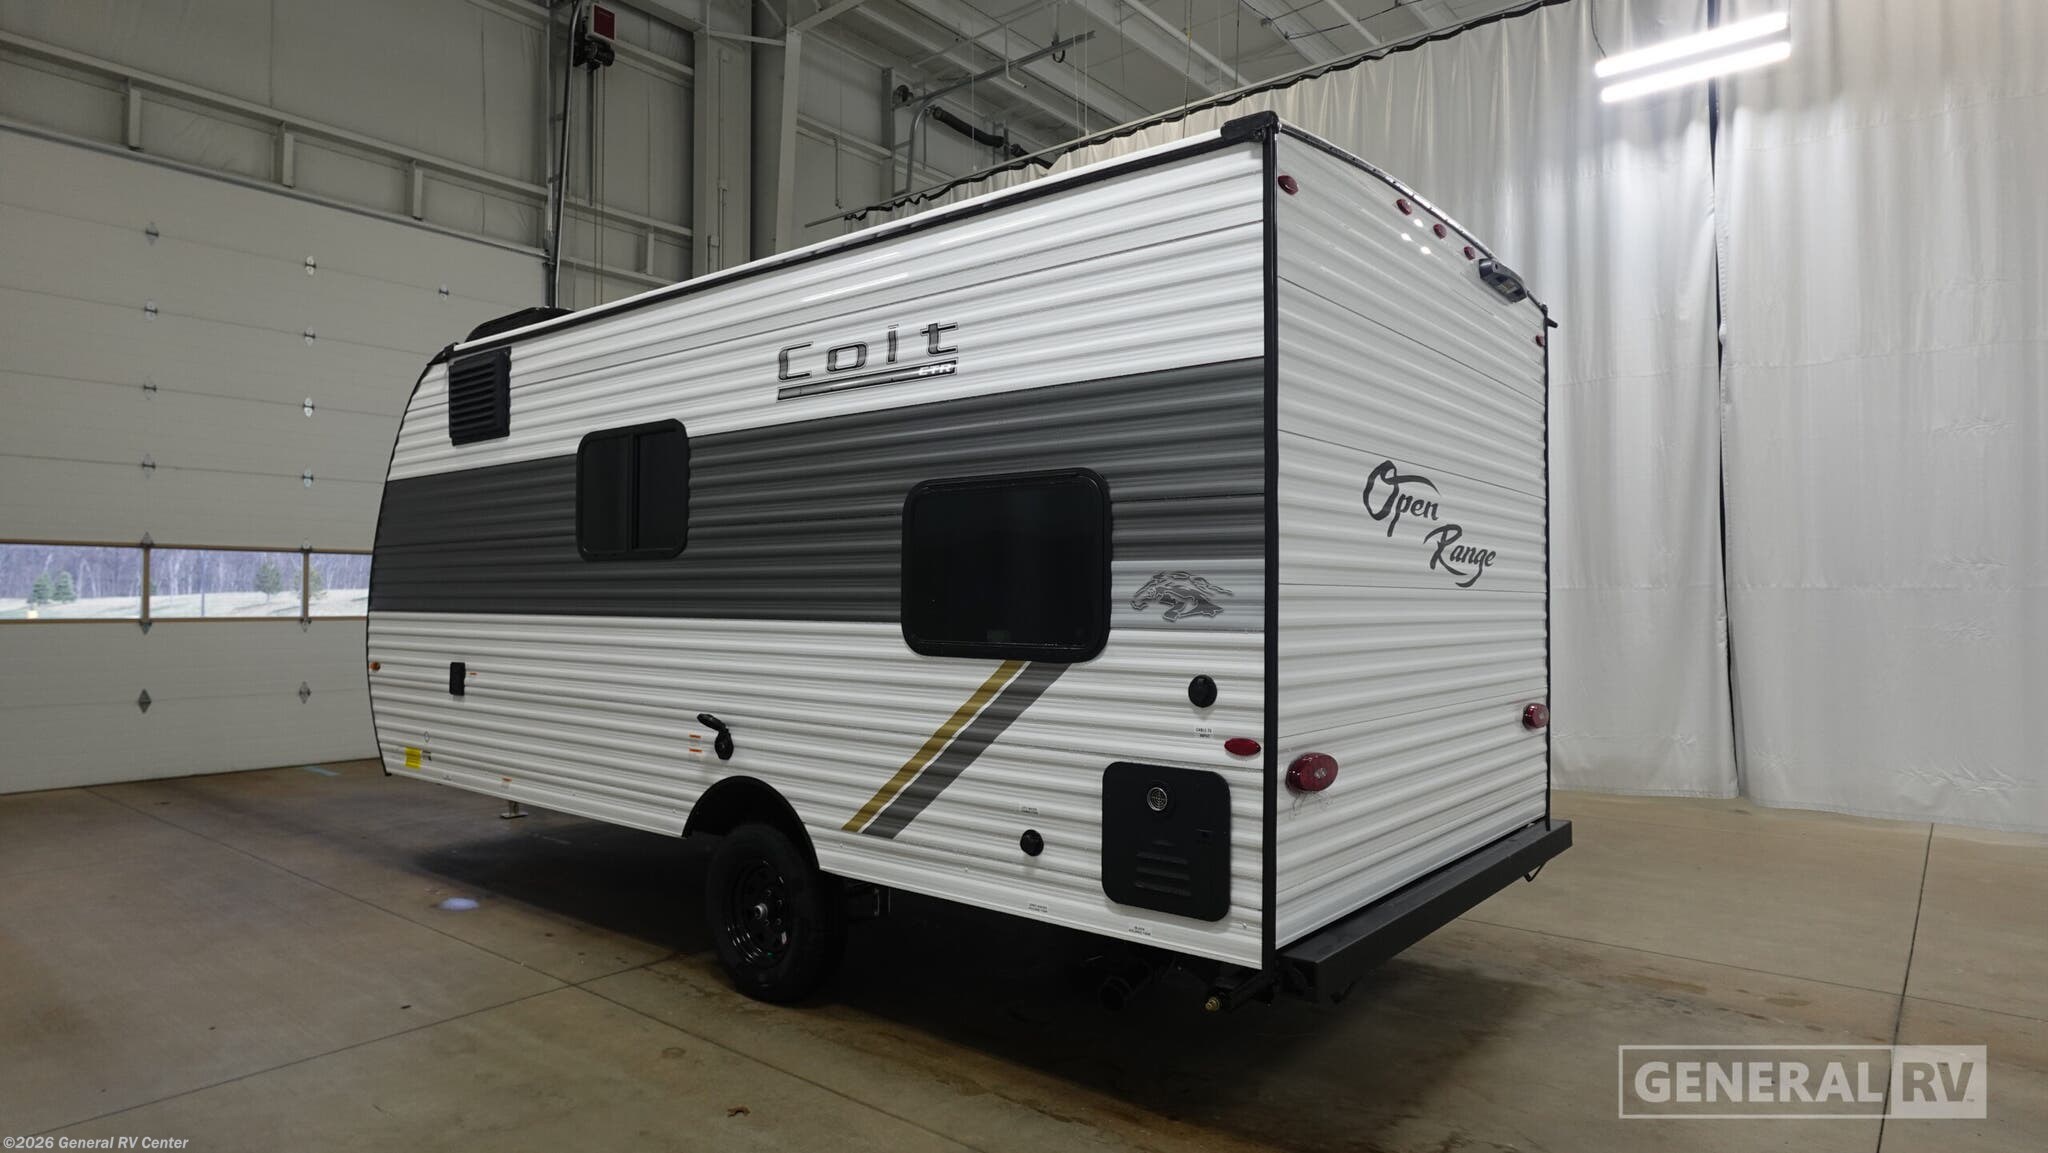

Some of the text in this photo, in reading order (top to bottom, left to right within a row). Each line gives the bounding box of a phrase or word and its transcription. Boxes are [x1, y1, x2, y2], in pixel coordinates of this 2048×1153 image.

[778, 322, 959, 382] Colt
[1363, 460, 1441, 538] Open
[1423, 524, 1497, 588] Range
